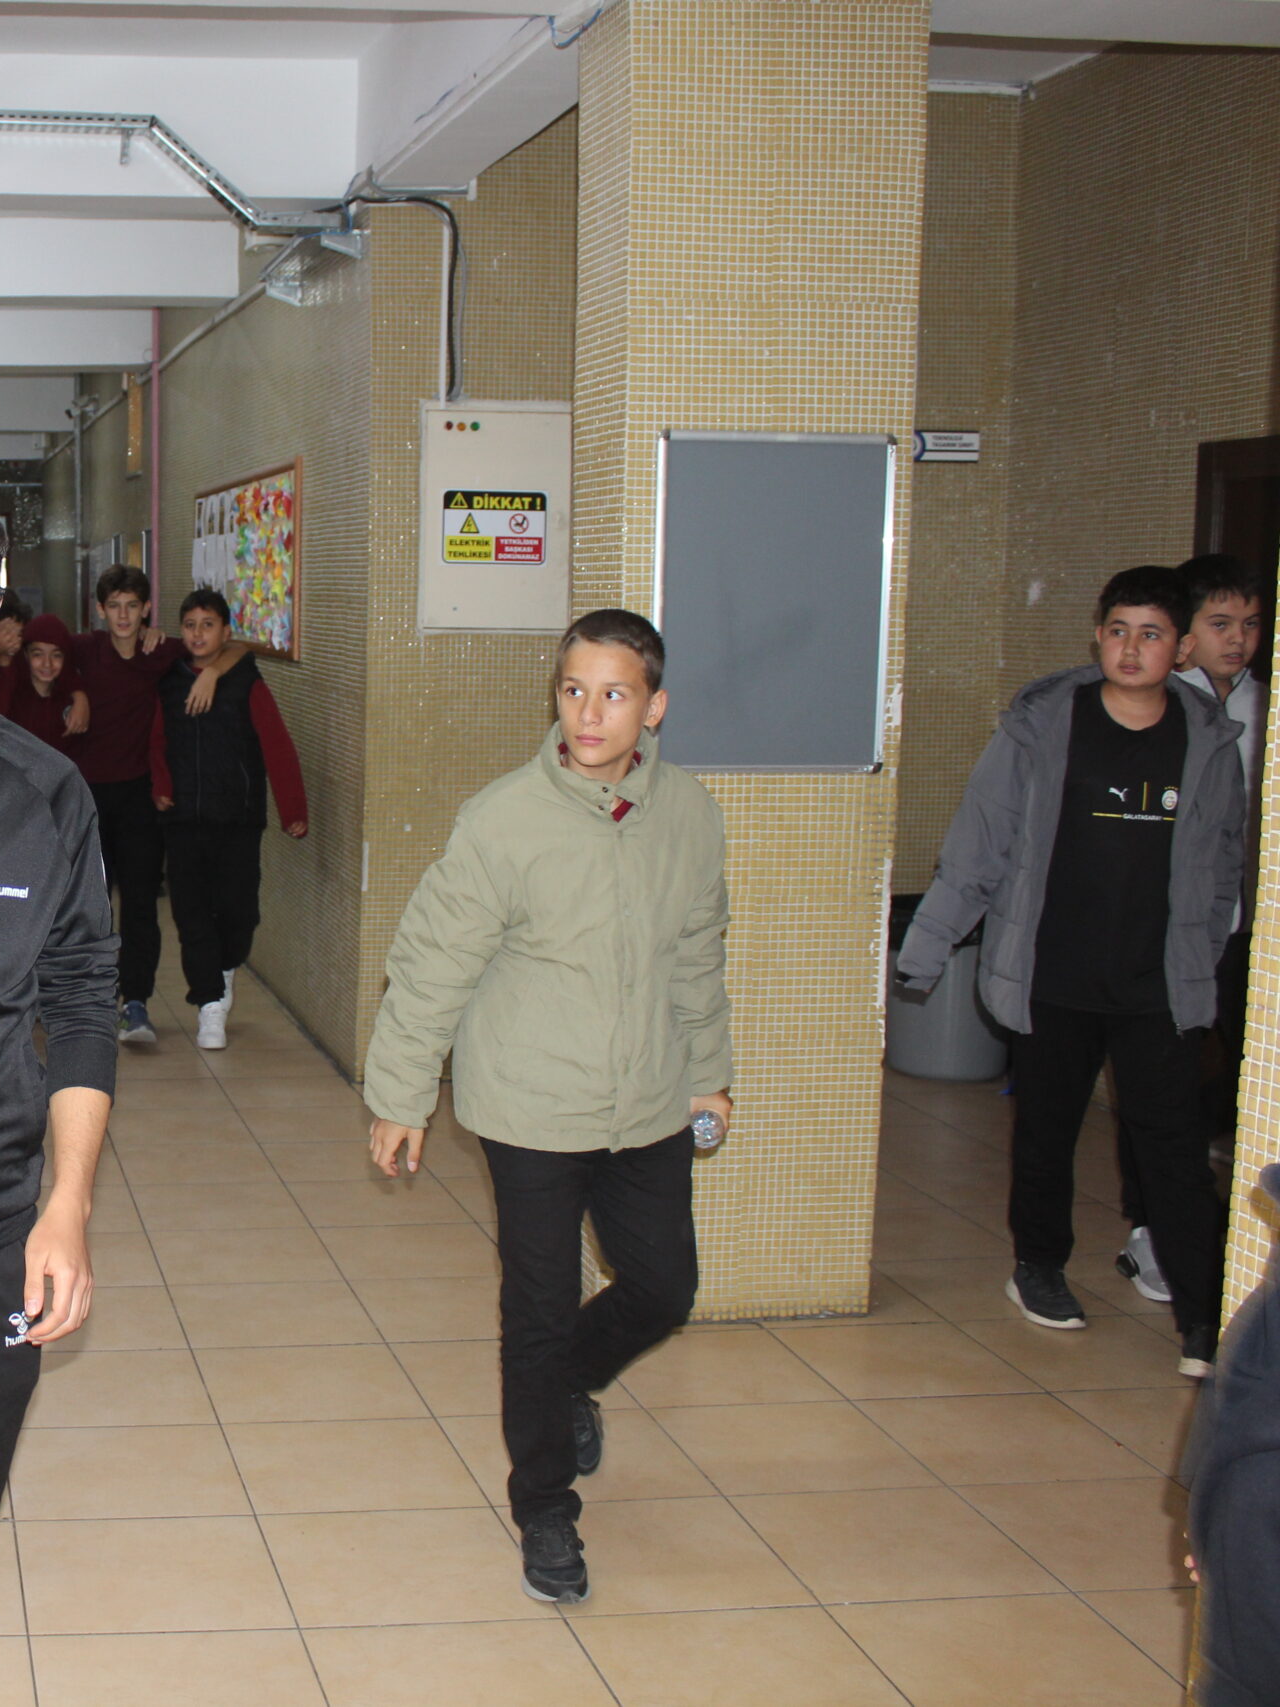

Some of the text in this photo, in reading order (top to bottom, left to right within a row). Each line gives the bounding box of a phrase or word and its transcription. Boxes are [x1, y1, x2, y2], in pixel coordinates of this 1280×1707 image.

[472, 493, 541, 511] DİKKAT !
[449, 538, 490, 547] ELEKTRİK
[447, 550, 492, 559] TEHLİKESİ
[5, 1335, 27, 1347] hum
